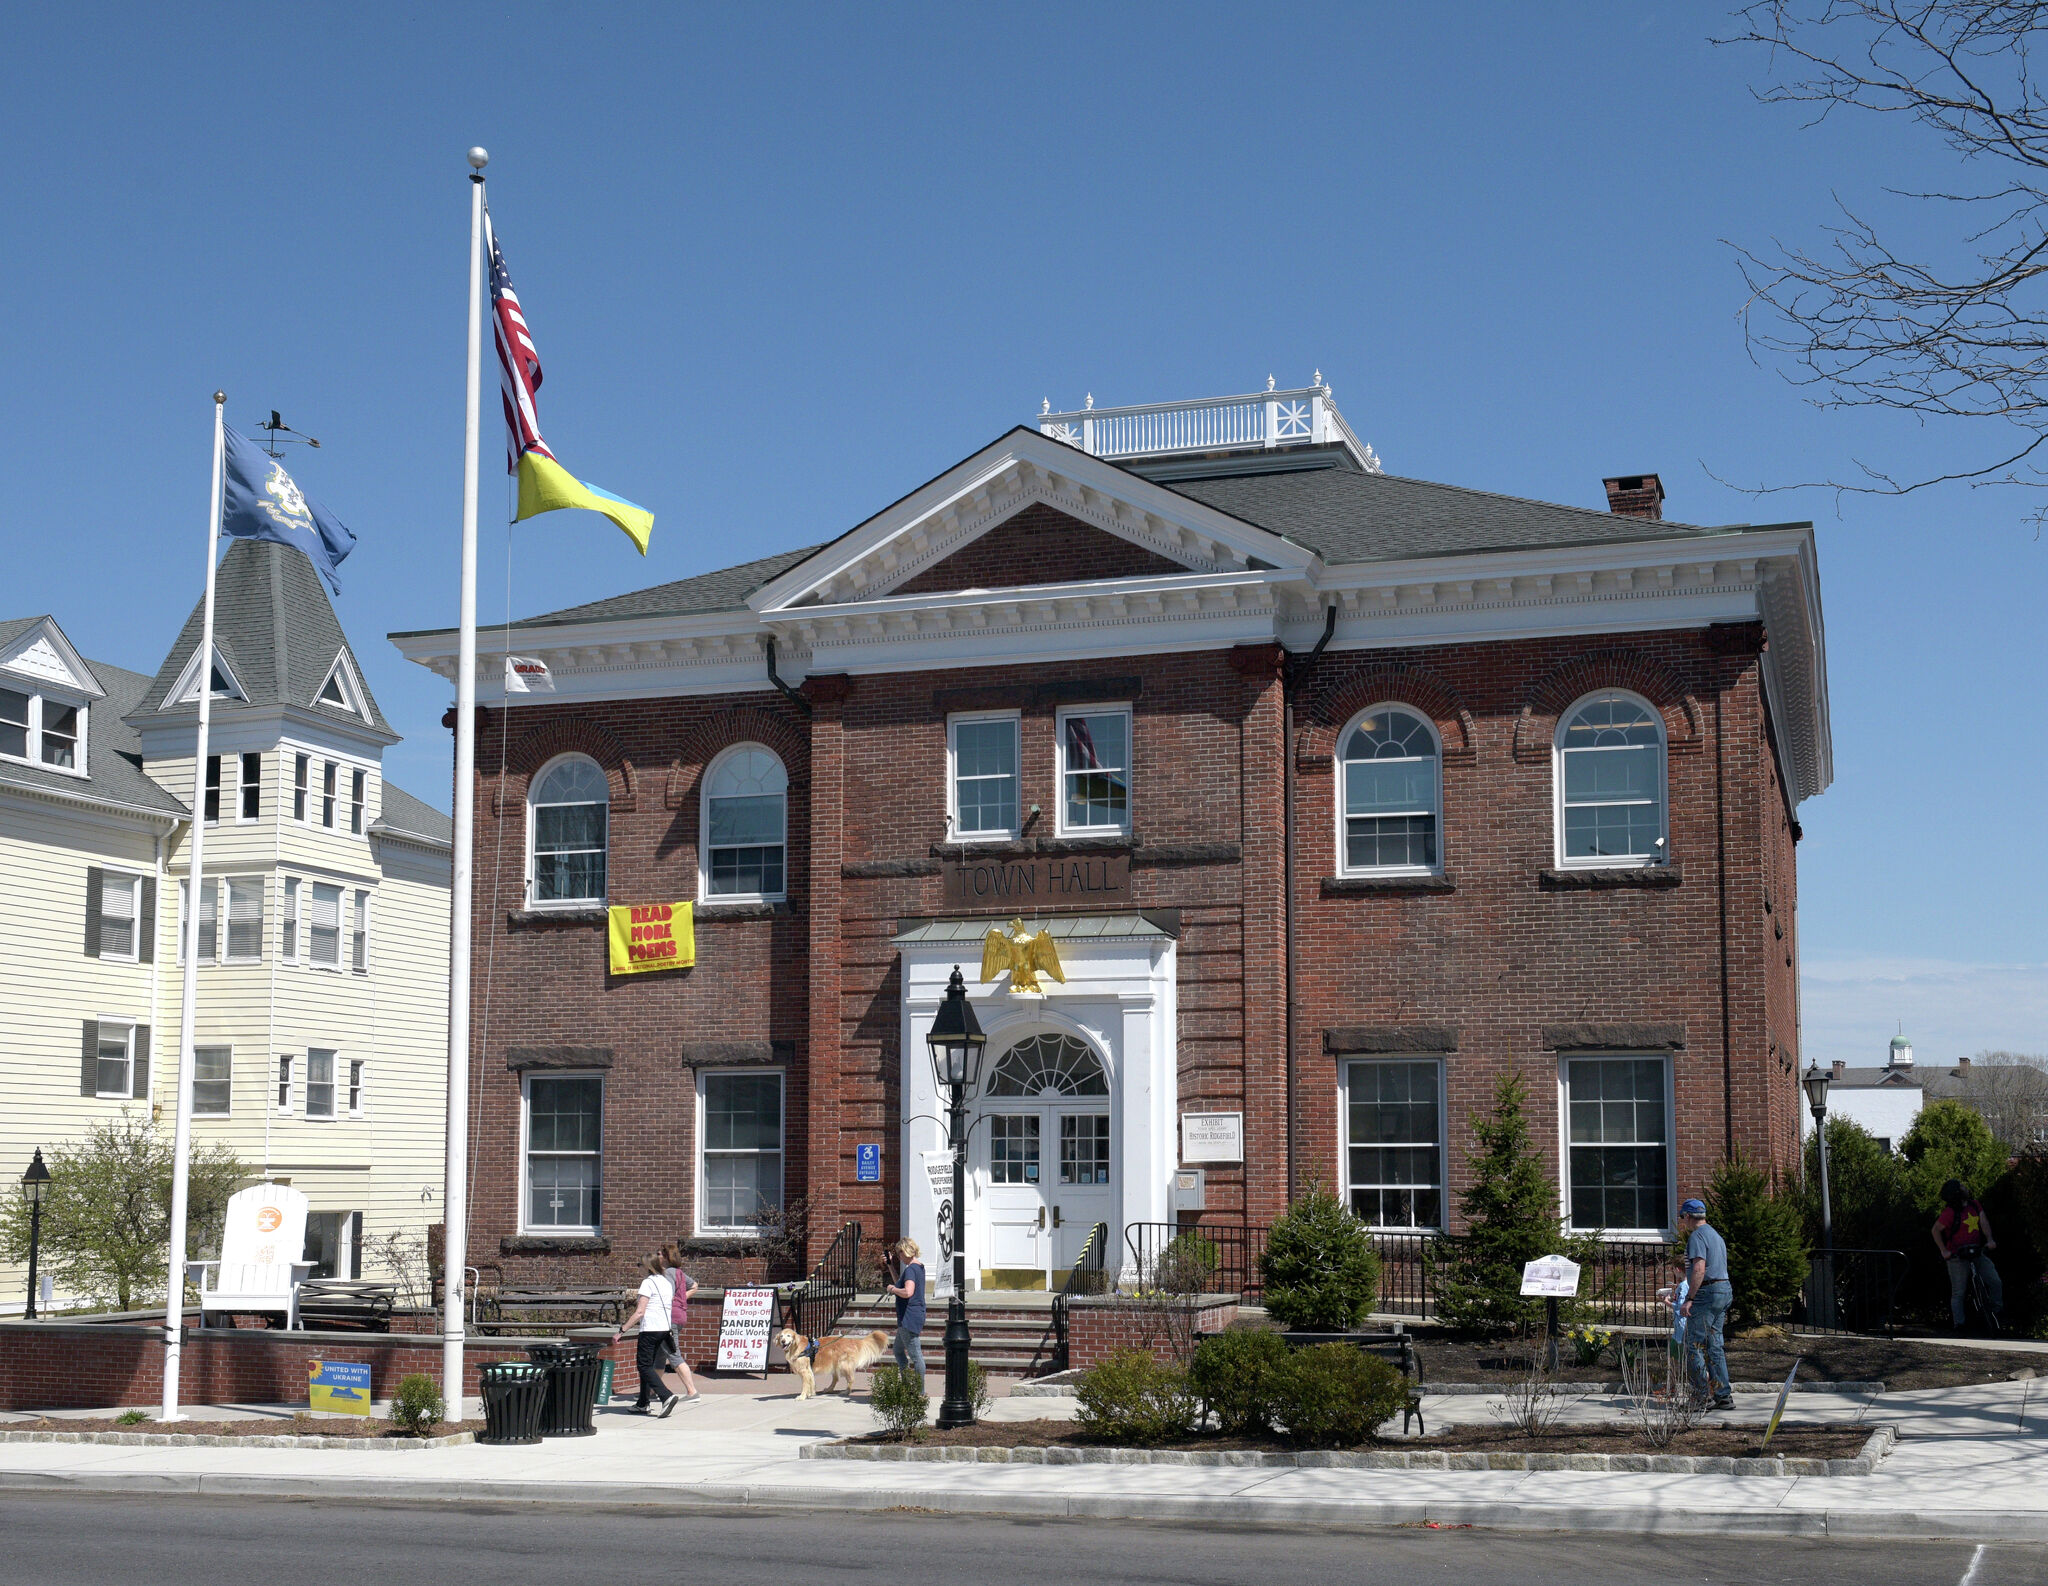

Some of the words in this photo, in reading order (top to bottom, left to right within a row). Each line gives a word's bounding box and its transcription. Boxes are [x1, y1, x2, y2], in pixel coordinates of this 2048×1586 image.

[955, 864, 1035, 897] TOWN
[631, 905, 672, 923] READ
[631, 923, 672, 942] MORE
[628, 940, 677, 961] POEMS
[1201, 1118, 1223, 1126] EXHIBIT
[1189, 1131, 1208, 1140] HISTORIC
[1209, 1131, 1235, 1140] RIDGEFIELD
[927, 1164, 953, 1175] RIDGEFIELD
[724, 1289, 774, 1298] Hazardous
[734, 1298, 763, 1307] Waste
[724, 1308, 739, 1317] Free
[740, 1308, 772, 1317] Drop-Off
[721, 1319, 771, 1328] DANBURY
[720, 1328, 744, 1337] Public
[745, 1328, 770, 1337] Works
[720, 1338, 748, 1349] APRIL
[718, 1361, 764, 1370] www.HRRA.org
[350, 1367, 369, 1375] WITH
[332, 1374, 362, 1382] UKRAINE
